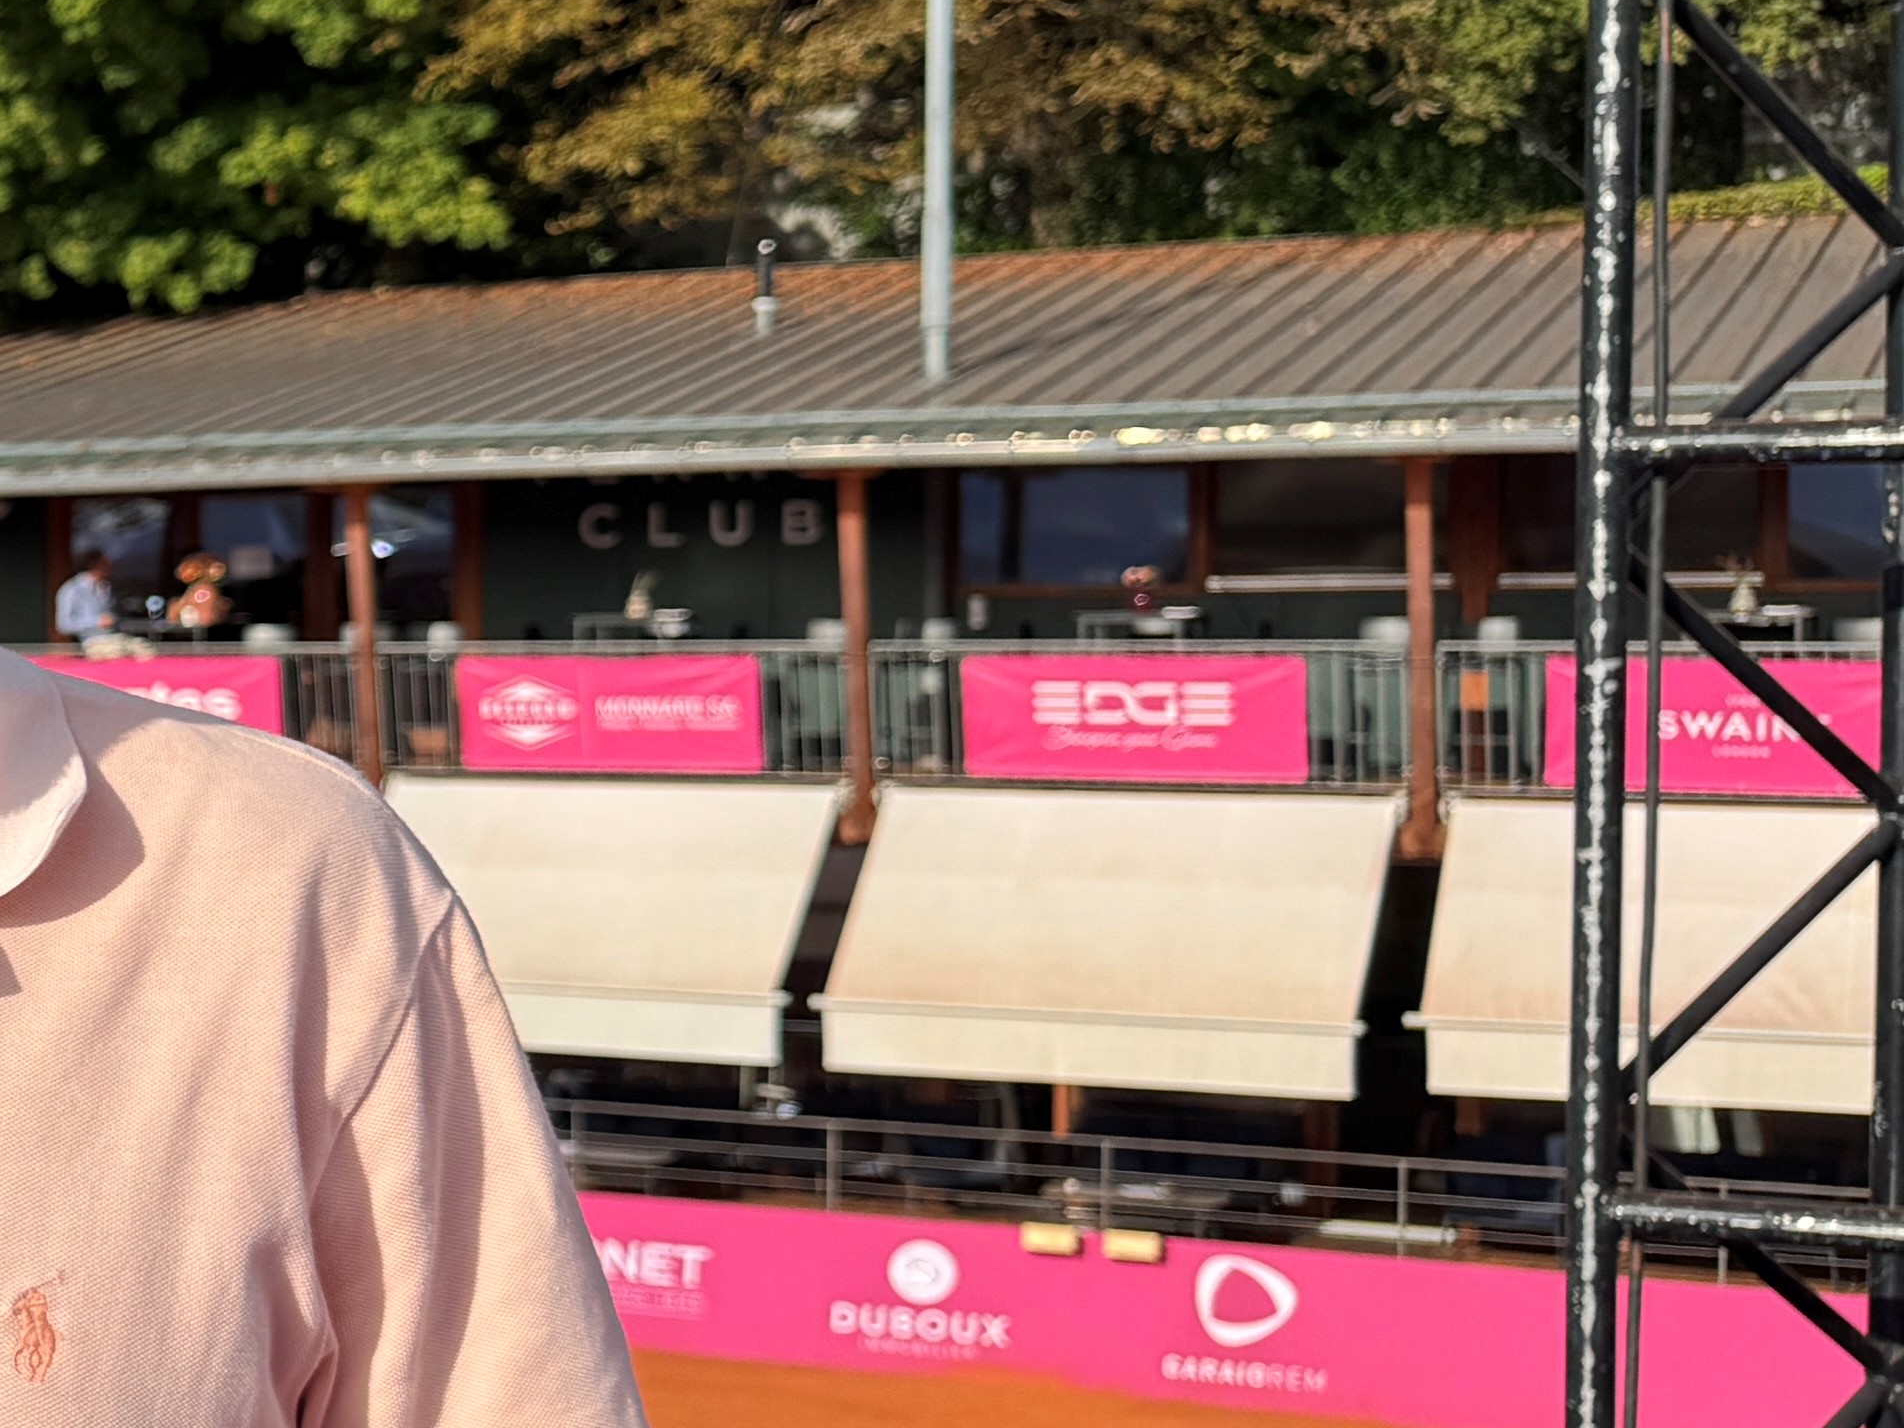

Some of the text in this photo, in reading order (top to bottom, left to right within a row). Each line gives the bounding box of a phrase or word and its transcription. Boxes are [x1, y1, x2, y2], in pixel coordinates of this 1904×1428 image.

[577, 498, 824, 549] CLUB
[1031, 680, 1235, 726] EDGE
[1657, 709, 1832, 742] SWAIN
[594, 1236, 714, 1289] NET
[829, 1300, 1013, 1349] DUBOUX
